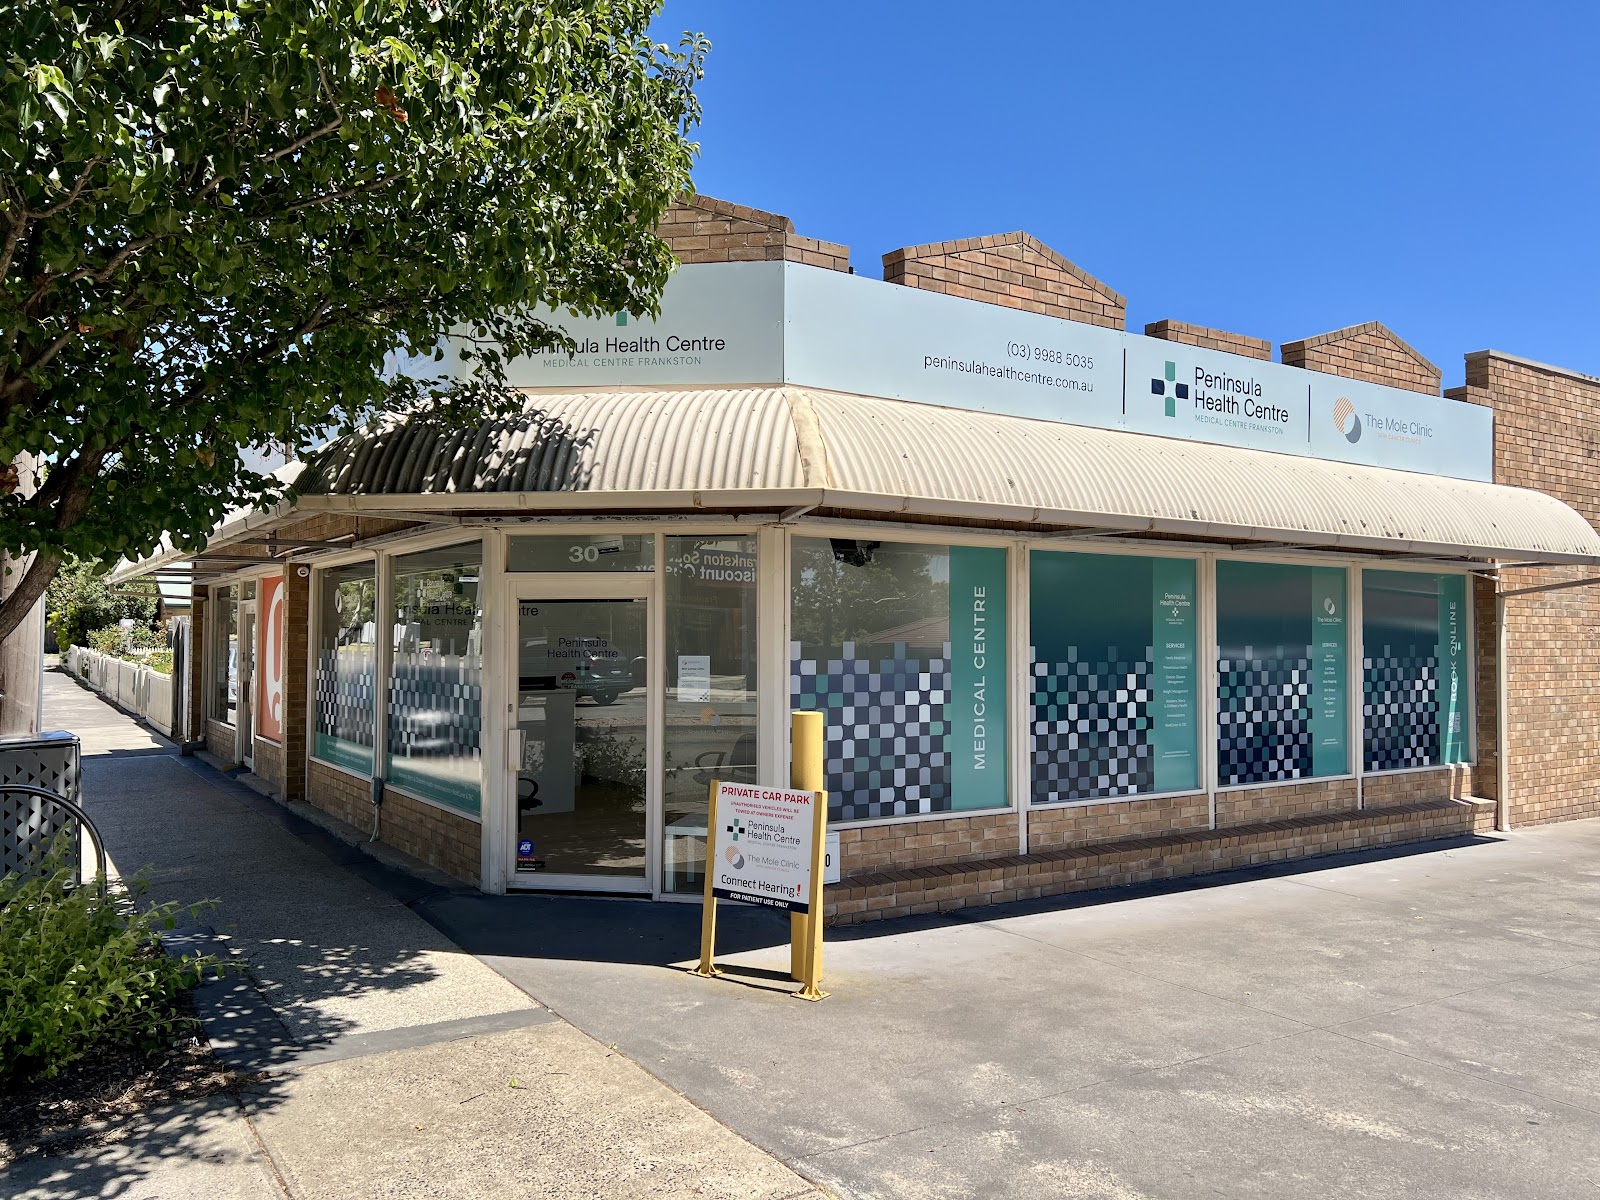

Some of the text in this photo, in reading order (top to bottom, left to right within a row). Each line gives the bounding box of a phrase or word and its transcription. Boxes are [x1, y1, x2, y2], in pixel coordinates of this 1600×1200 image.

[606, 337, 660, 353] Health
[666, 336, 726, 351] Centre
[543, 356, 701, 368] MEDICAL CENTRE FRANKSTON
[1007, 340, 1094, 370] (03) 9988 5035
[924, 354, 1094, 392] peninsulahealthcentre.com.au
[1195, 366, 1262, 397] Peninsula
[1195, 389, 1289, 423] Health Centre
[1195, 414, 1283, 435] MEDICAL CENTRE FRANKSTON
[1365, 413, 1433, 438] The Mole Clinic
[568, 546, 599, 562] 30
[558, 636, 608, 648] Peninsula
[547, 649, 619, 658] Health Centre
[974, 586, 986, 770] MEDICAL CENTRE
[722, 786, 810, 805] PRIVATE CAR PARK
[731, 801, 761, 809] UNAUTHORISED
[748, 820, 785, 834] Peninsula
[747, 830, 800, 845] Health Centre
[747, 854, 800, 869] The Mole Clinic
[721, 874, 795, 897] Connect Hearing
[742, 894, 763, 904] PATIENT
[775, 900, 789, 908] ONLY
